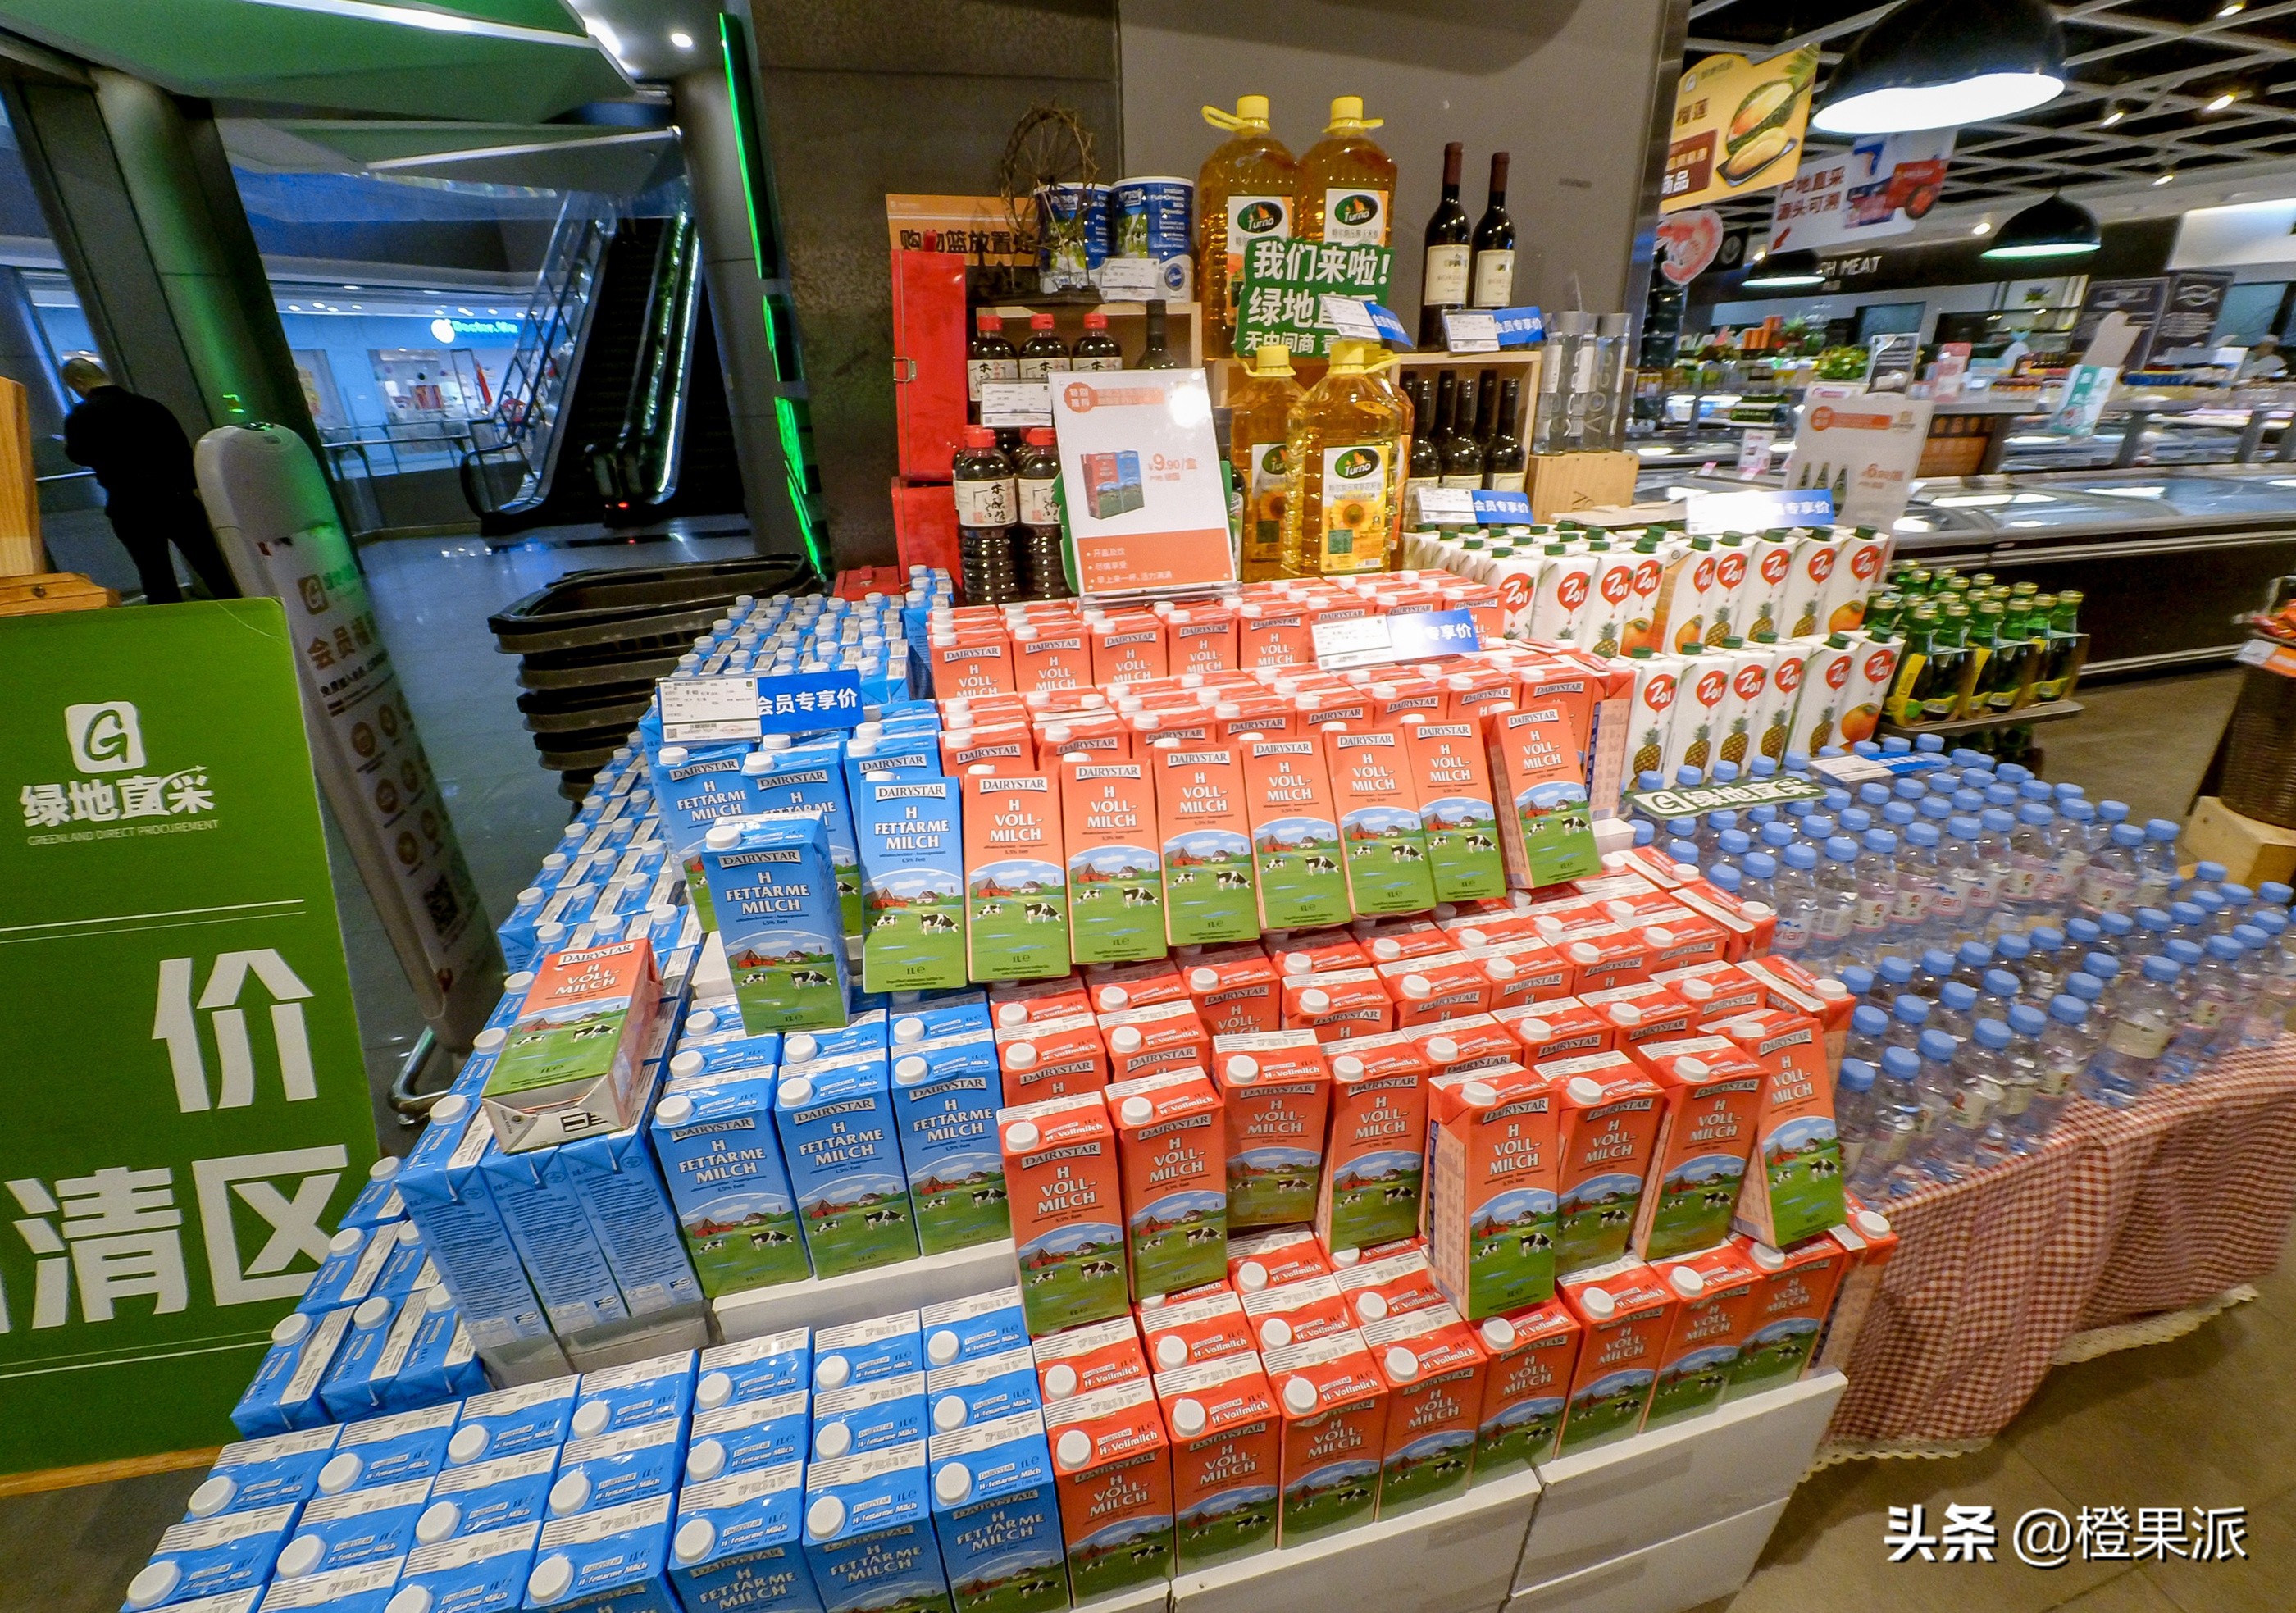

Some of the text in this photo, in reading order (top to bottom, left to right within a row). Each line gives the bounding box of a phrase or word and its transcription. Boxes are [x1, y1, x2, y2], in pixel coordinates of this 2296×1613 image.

[1253, 240, 1392, 285] 我们来啦!
[1839, 256, 1883, 276] MEAT
[1247, 287, 1378, 329] 绿地直
[1474, 499, 1529, 514] 会员专享价
[1105, 631, 1155, 645] DAIRYSTAR
[1180, 623, 1229, 637] DAIRYSTAR
[945, 646, 1000, 661] DAIRYSTAR
[1026, 637, 1079, 653] DAIRYSTAR
[1534, 682, 1584, 698] DAIRYSTAR
[758, 687, 858, 717] 会员专享价
[1387, 696, 1439, 713] DAIRYSTAR
[1229, 718, 1287, 733] DAIRYSTAR
[1309, 708, 1364, 724] DAIRYSTAR
[1509, 709, 1559, 727] DAIRYSTAR
[1339, 733, 1395, 748] DAIRYSTAR
[1419, 724, 1472, 739] DAIRYSTAR
[1530, 730, 1542, 742] H
[959, 744, 1021, 763] DAIRYSTAR
[1057, 737, 1118, 755] DAIRYSTAR
[1255, 741, 1312, 756] DAIRYSTAR
[1522, 740, 1560, 756] VOLL-
[861, 754, 927, 772] DAIRYSTAR
[1168, 750, 1230, 765] DAIRYSTAR
[1430, 754, 1471, 769] VOLL-
[1522, 753, 1563, 770] MILCH
[672, 760, 740, 780] DAIRYSTAR
[758, 770, 828, 788] DAIRYSTAR
[1077, 764, 1141, 779] DAIRYSTAR
[1351, 764, 1395, 780] VOLL-
[1428, 768, 1472, 783] MILCH
[982, 777, 1047, 793] DAIRYSTAR
[1267, 773, 1313, 789] VOLL-
[1351, 777, 1396, 793] MILCH
[20, 774, 216, 827] 绿地直采
[676, 789, 747, 811] FETTARME
[877, 785, 945, 800] DAIRYSTAR
[1182, 785, 1228, 800] VOLL-
[1266, 787, 1314, 802] MILCH
[690, 803, 743, 822] MILCH
[904, 805, 918, 820] H
[1008, 798, 1021, 812] H
[1090, 799, 1137, 813] VOLL-
[1179, 799, 1228, 813] MILCH
[873, 819, 950, 836] FETTARME
[993, 812, 1044, 827] VOLL-
[1086, 813, 1137, 829] MILCH
[27, 819, 220, 846] GREENLAND DIRECT PROCUREMENT
[989, 827, 1042, 843] MILCH
[885, 835, 941, 850] MILCH
[722, 850, 800, 868] DAIRYSTAR
[725, 884, 811, 902] FETTARME
[740, 898, 803, 915] MILCH
[561, 943, 632, 964] DAIRYSTAR
[554, 976, 617, 996] MILCH
[566, 968, 621, 985] VOLL-
[1205, 986, 1268, 1005] DAIRYSTAR
[152, 948, 318, 1114] 价
[1217, 1015, 1263, 1031] VOLL-
[1539, 1034, 1601, 1056] DAIRYSTAR
[1759, 1029, 1812, 1056] DAIRYSTAR
[1128, 1046, 1196, 1071] DAIRYSTAR
[1022, 1061, 1093, 1084] DAIRYSTAR
[1770, 1069, 1812, 1089] VOLL-
[912, 1078, 986, 1100] DAIRYSTAR
[1242, 1084, 1314, 1098] DAIRYSTAR
[1348, 1076, 1418, 1096] DAIRYSTAR
[1771, 1082, 1814, 1105] MILCH
[797, 1099, 874, 1123] DAIRYSTAR
[1252, 1110, 1307, 1123] VOLL-
[1360, 1109, 1410, 1125] VOLL-
[1483, 1098, 1549, 1123] DAIRYSTAR
[1588, 1099, 1652, 1121] DAIRYSTAR
[673, 1118, 753, 1139] DAIRYSTAR
[912, 1108, 995, 1133] FETTARME
[1140, 1114, 1210, 1139] DAIRYSTAR
[1246, 1122, 1304, 1136] MILCH
[926, 1122, 986, 1143] MILCH
[1354, 1121, 1406, 1140] MILCH
[1592, 1130, 1637, 1148] VOLL-
[799, 1128, 885, 1156] FETTARME
[1493, 1138, 1542, 1157] VOLL-
[677, 1147, 767, 1173] FETTARME
[813, 1143, 877, 1166] MILCH
[1024, 1142, 1100, 1169] DAIRYSTAR
[1152, 1150, 1205, 1168] VOLL-
[1584, 1144, 1633, 1164] MILCH
[695, 1161, 758, 1184] MILCH
[1149, 1161, 1205, 1184] MILCH
[1489, 1153, 1541, 1176] MILCH
[1040, 1178, 1098, 1197] VOLL-
[1036, 1191, 1098, 1216] MILCH
[0, 1143, 349, 1333] 清区
[1323, 1378, 1378, 1401] H-Vollmilch
[1212, 1401, 1269, 1424] H-Vollmilch
[1099, 1431, 1158, 1456] H-Vollmilch
[1204, 1451, 1260, 1471] VOLL-
[1199, 1460, 1257, 1486] MILCH
[1092, 1482, 1149, 1503] VOLL-
[1088, 1491, 1149, 1519] MILCH
[955, 1511, 1046, 1546] FETTARME
[971, 1524, 1035, 1553] MILCH
